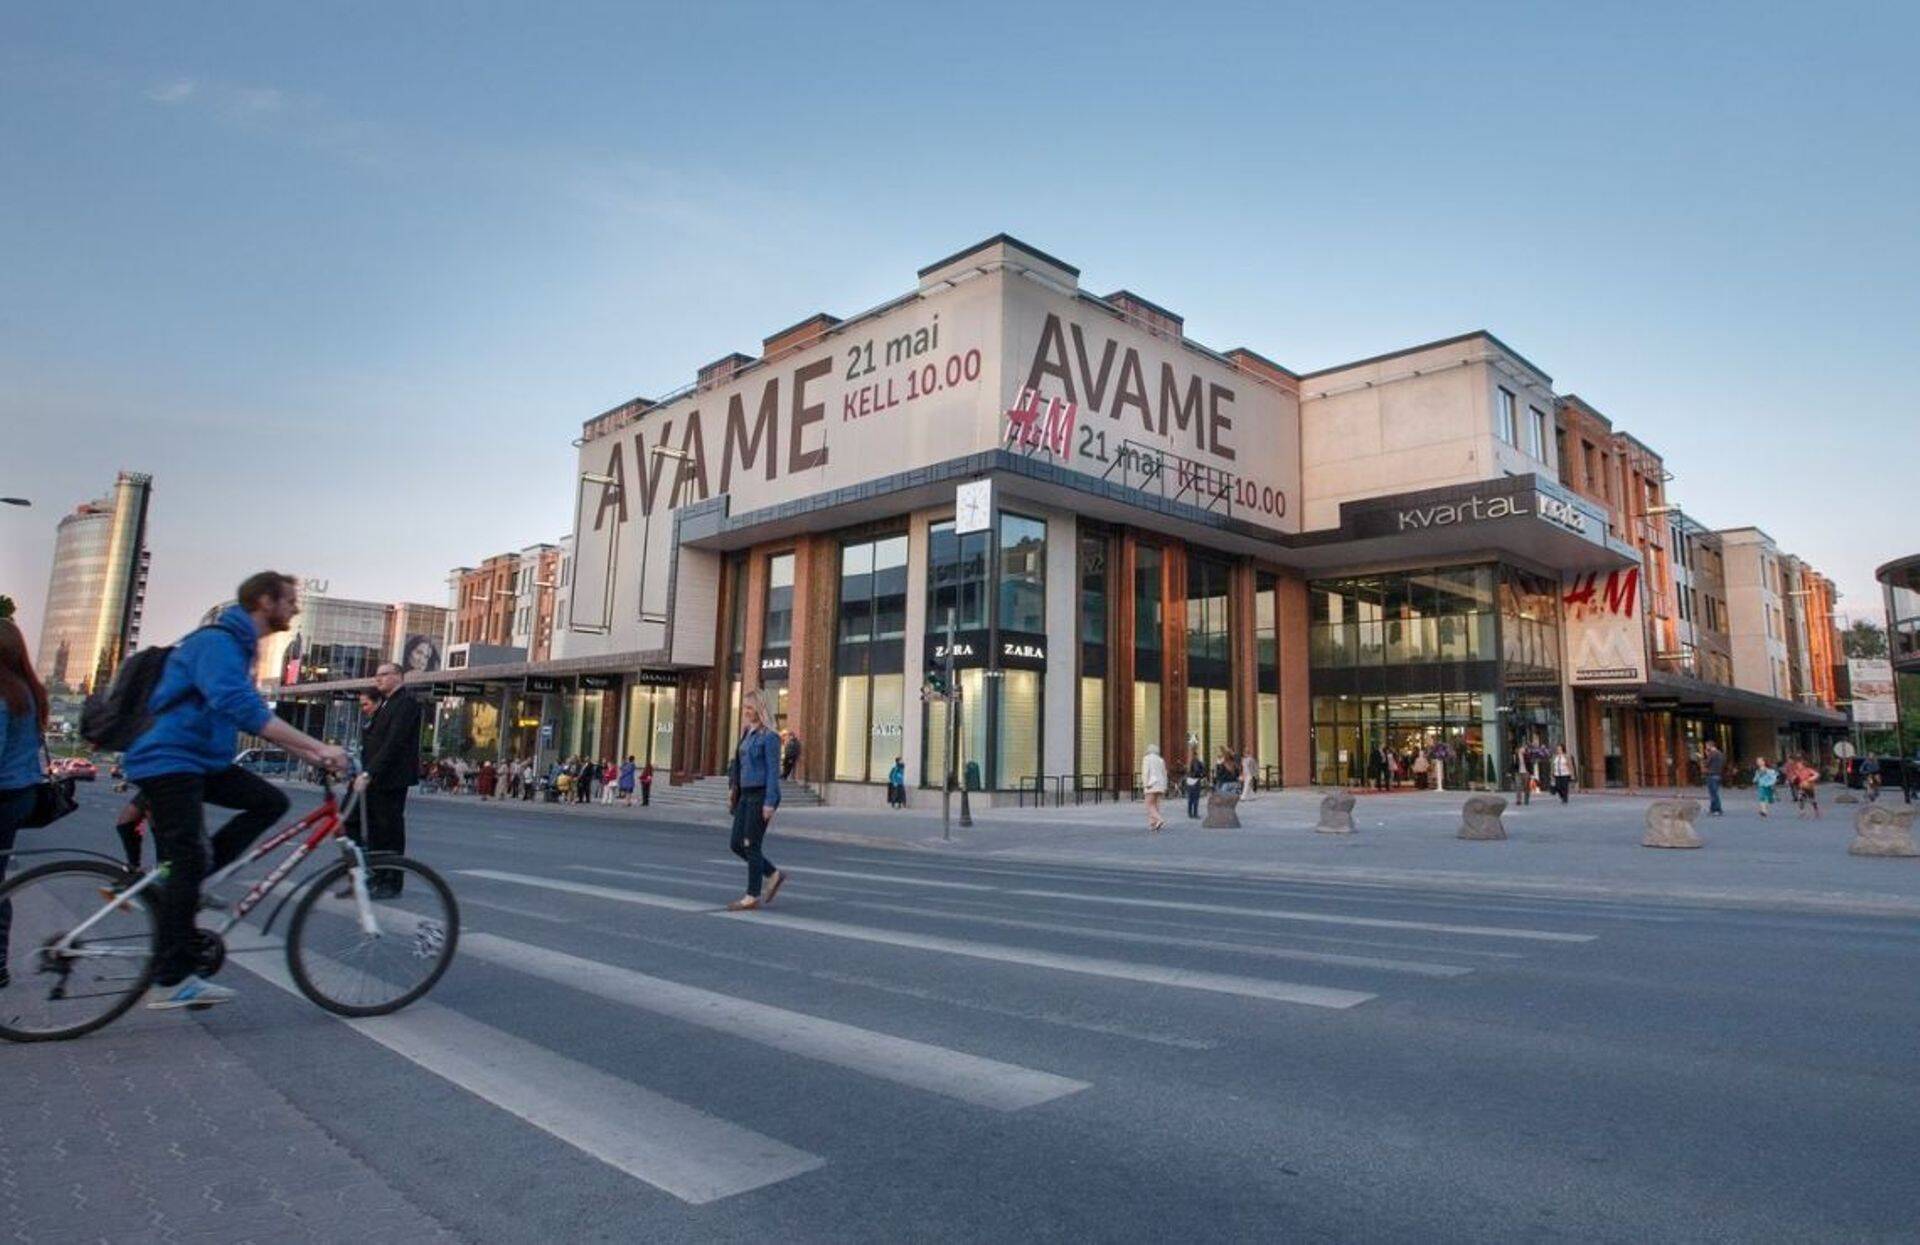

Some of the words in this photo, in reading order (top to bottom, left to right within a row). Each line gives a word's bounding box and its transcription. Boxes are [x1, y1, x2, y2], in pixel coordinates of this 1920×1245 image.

[846, 339, 876, 381] 21
[886, 313, 939, 366] mai
[843, 378, 900, 422] KELL
[907, 348, 982, 401] 10.00
[1026, 311, 1237, 461] AVAME
[594, 356, 833, 531] AVAME
[1079, 425, 1110, 463] 21
[1117, 443, 1164, 479] mai
[1178, 457, 1231, 500] KELL
[1234, 477, 1287, 518] 10.00
[762, 658, 789, 669] ZARA
[1004, 643, 1045, 659] ZARA
